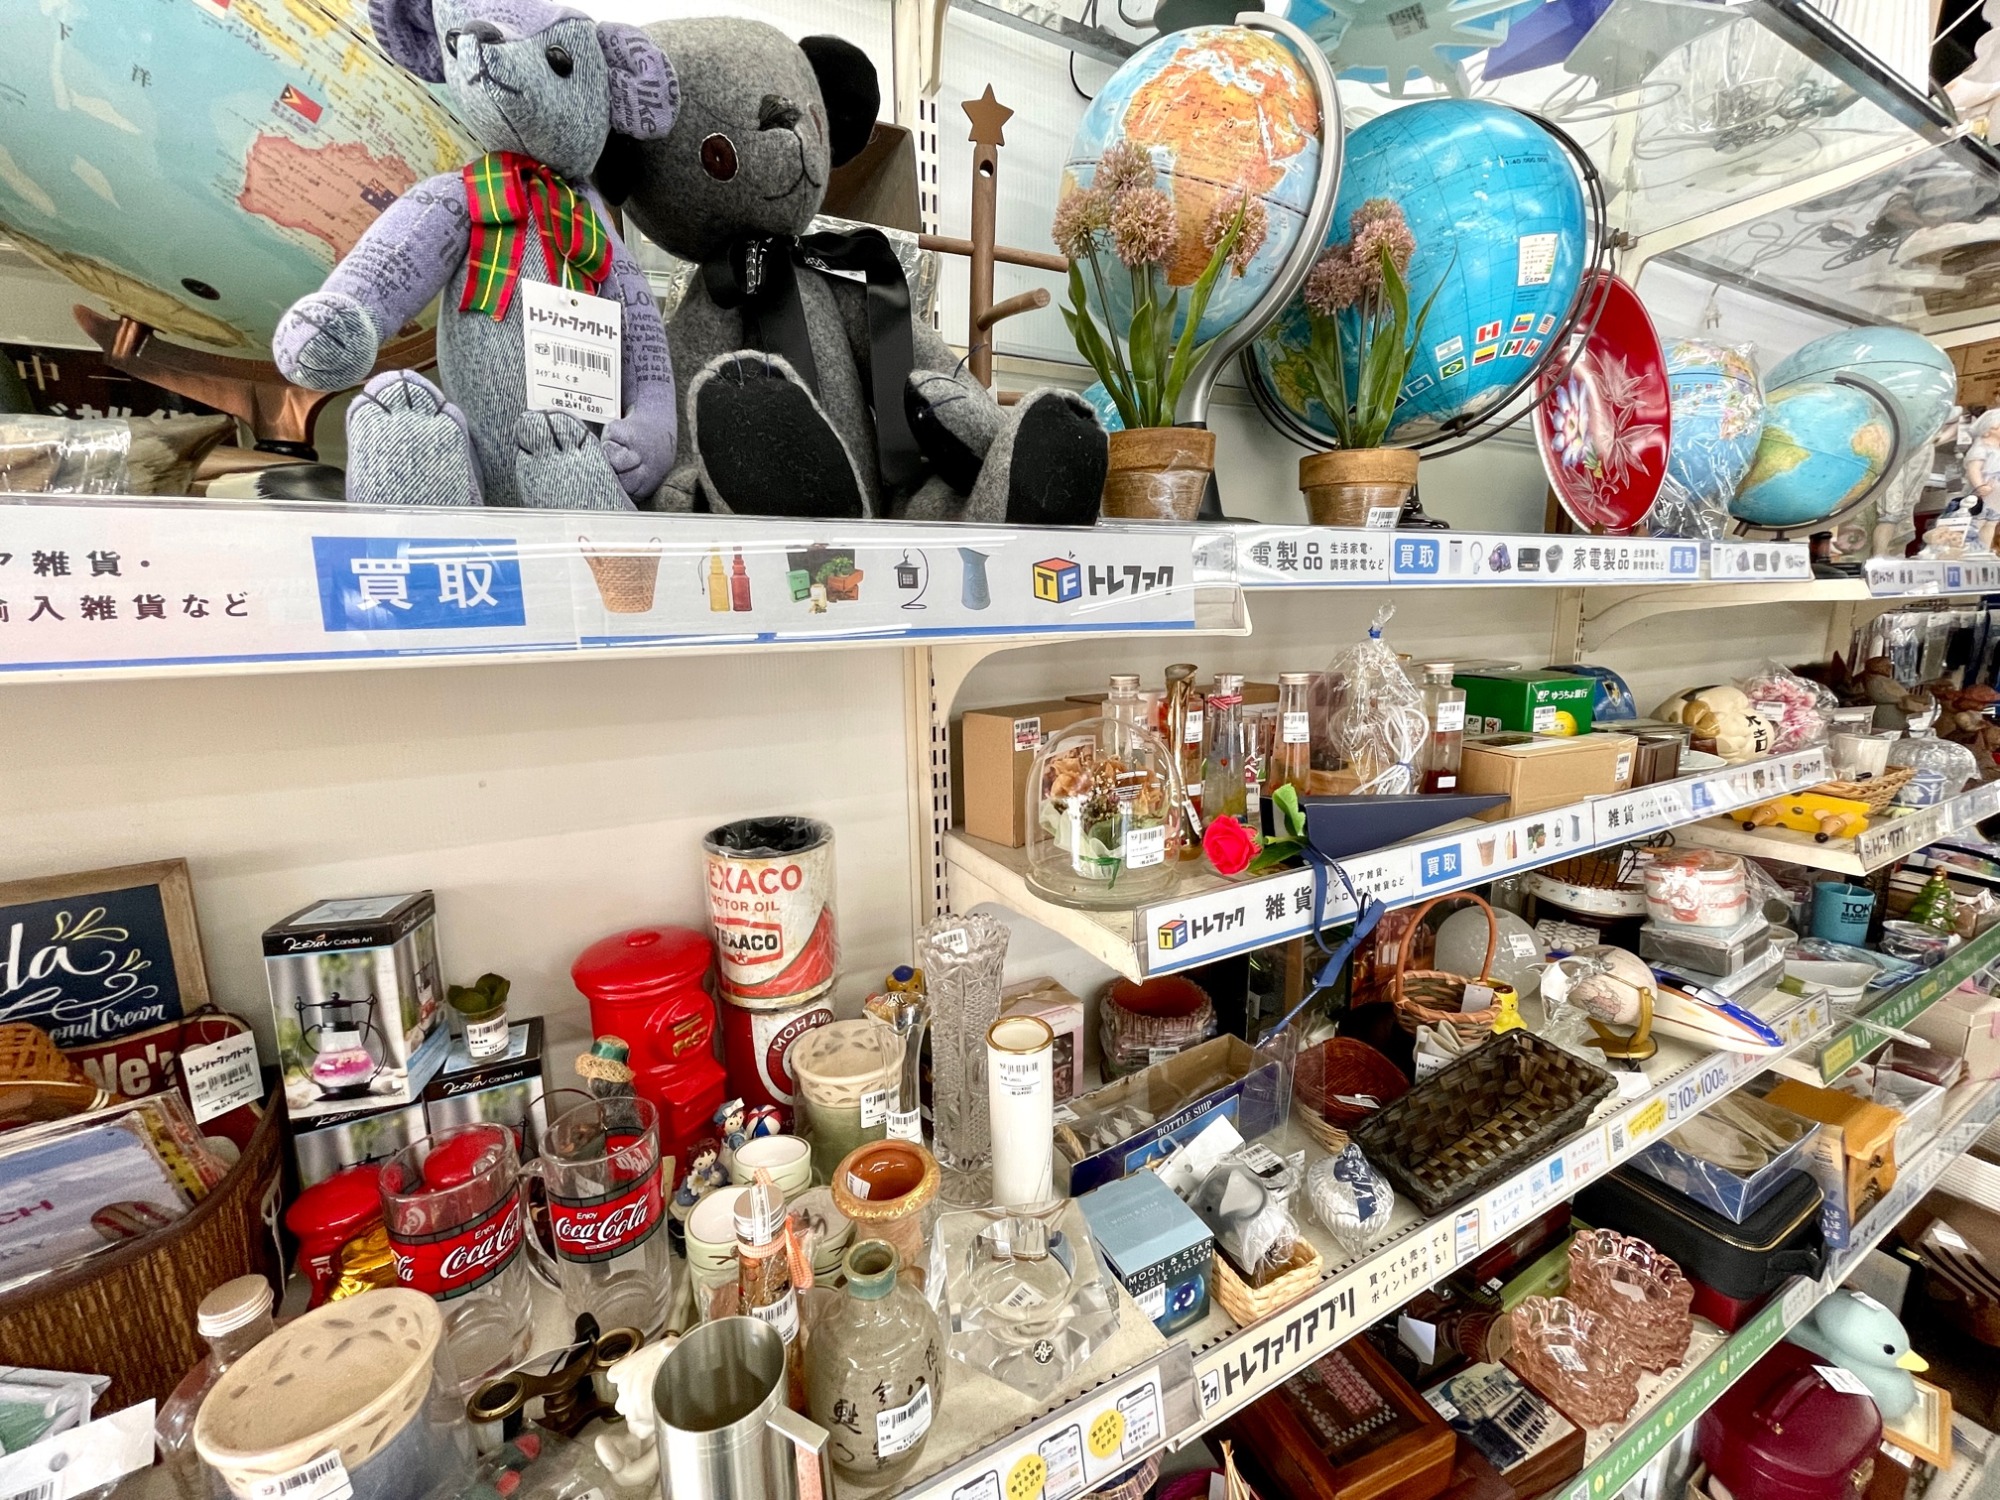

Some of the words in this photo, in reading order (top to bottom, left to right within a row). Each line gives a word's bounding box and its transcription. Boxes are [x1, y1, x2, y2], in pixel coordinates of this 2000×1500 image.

[530, 307, 618, 340] トレジャーファクトリー
[1330, 558, 1385, 571] 調理家電など
[1399, 544, 1435, 569] 買取
[1573, 547, 1630, 571] 家電製品
[1672, 551, 1694, 569] 買取
[350, 557, 500, 611] 買取
[1088, 564, 1174, 597] トレファク
[1551, 688, 1588, 701] ゆうちょ銀行
[1608, 803, 1634, 828] 雑貨
[1427, 853, 1457, 878] 買取
[1326, 867, 1389, 890] インリア雑貨・
[754, 901, 780, 912] OIL
[1266, 885, 1312, 921] 雑貨
[1192, 907, 1245, 940] トレファク
[334, 938, 360, 946] Candle
[101, 1004, 167, 1032] Cream
[488, 1074, 512, 1084] Candle
[513, 1070, 524, 1078] Art
[1157, 1110, 1192, 1138] BOTTLE
[1193, 1100, 1213, 1118] SHIP
[555, 1192, 650, 1243] Coca-Cola
[576, 1211, 598, 1221] Enjoy
[474, 1222, 496, 1241] Enjoy
[1128, 1263, 1165, 1286] MOON
[1170, 1257, 1178, 1266] &
[1182, 1240, 1212, 1260] STAR
[1174, 1252, 1212, 1275] HOLDER
[1368, 1231, 1449, 1288] 買っても売っても
[1223, 1286, 1355, 1397] トレファクアプリ
